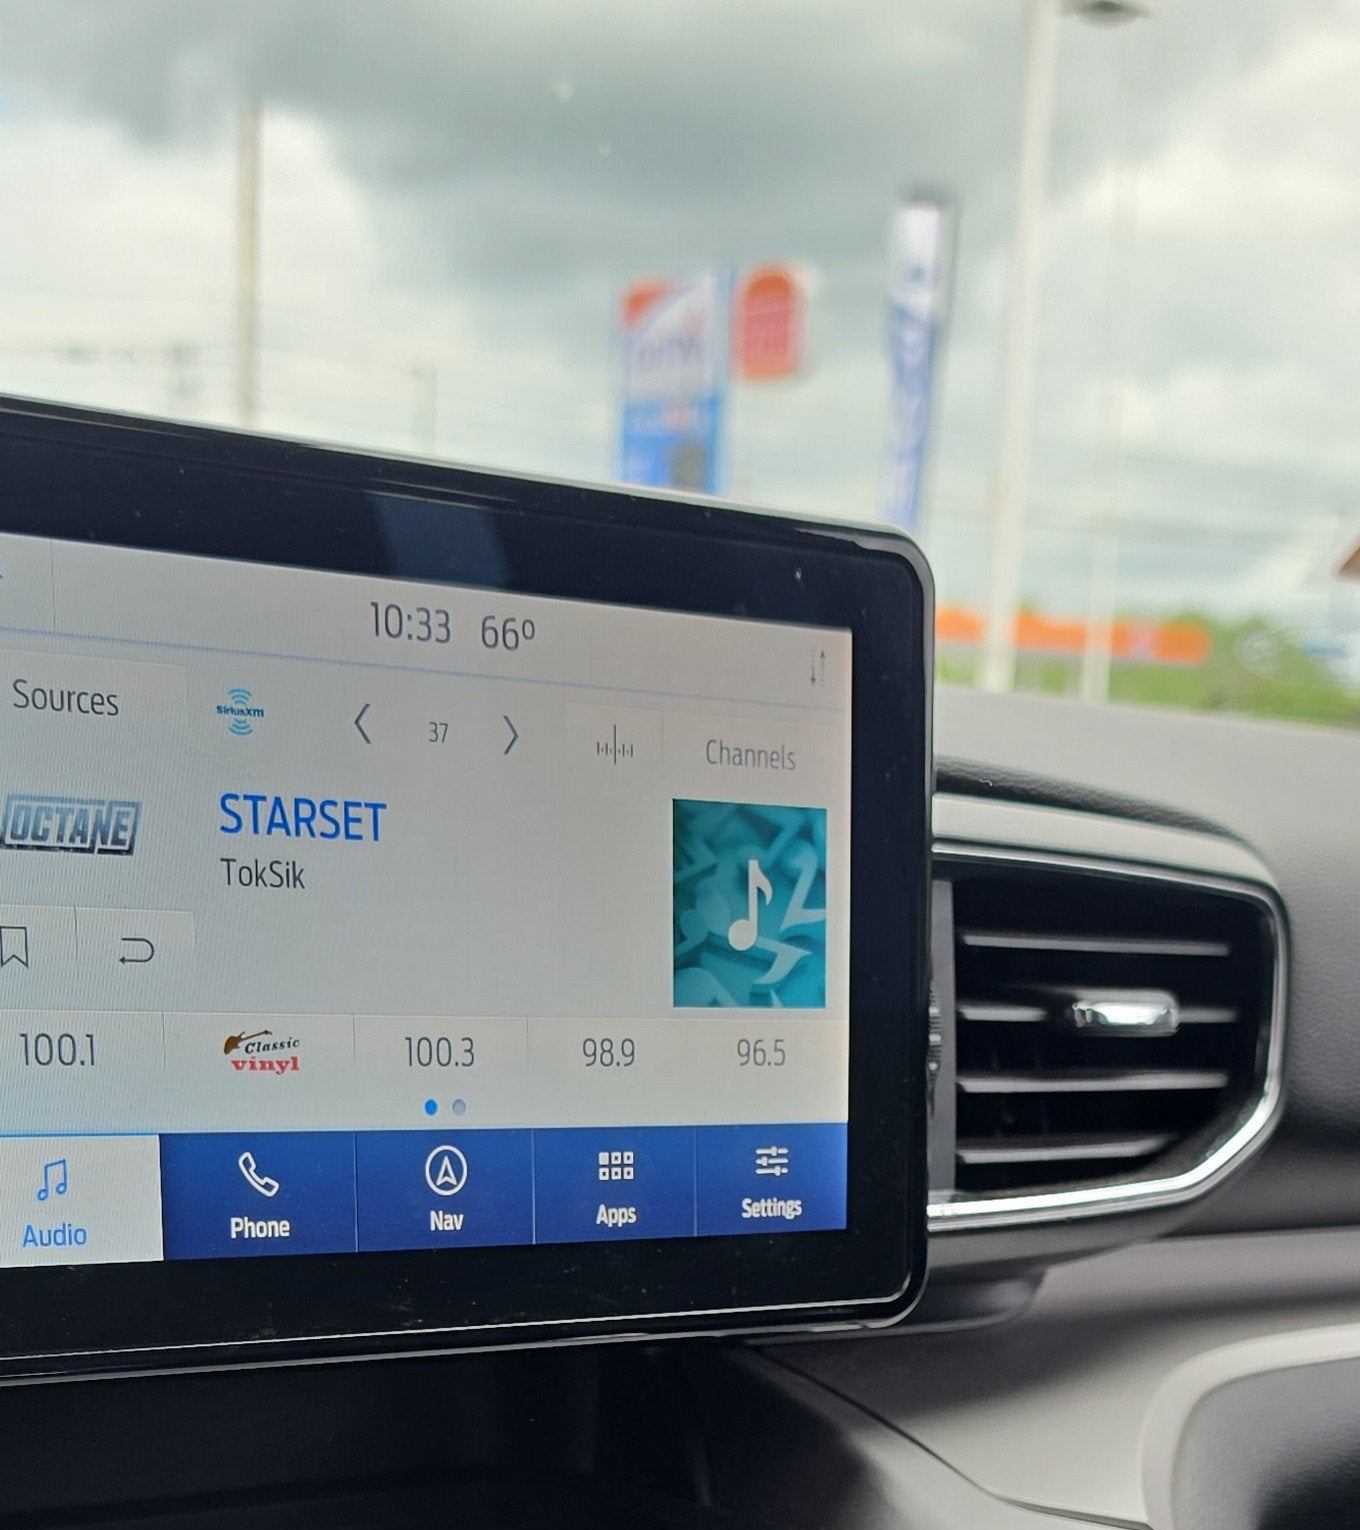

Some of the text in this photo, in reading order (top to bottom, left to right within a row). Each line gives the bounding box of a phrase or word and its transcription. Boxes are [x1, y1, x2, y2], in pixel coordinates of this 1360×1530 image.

[370, 601, 451, 643] 10:33
[12, 679, 119, 716] Sources
[428, 722, 448, 744] 37
[705, 740, 796, 771] Channels
[11, 804, 130, 846] OCTANE
[219, 793, 387, 841] STARSET
[220, 858, 306, 890] TokSik
[20, 1033, 96, 1067] 100.1
[245, 1037, 300, 1054] Classic
[405, 1037, 475, 1067] 100.3
[581, 1038, 636, 1067] 98.9
[736, 1039, 786, 1067] 96.5
[231, 1056, 299, 1075] vinyl
[429, 1210, 464, 1232] Nav
[596, 1203, 637, 1228] Apps
[741, 1197, 803, 1222] Settings
[23, 1223, 87, 1248] Audio
[230, 1217, 290, 1239] Phone
